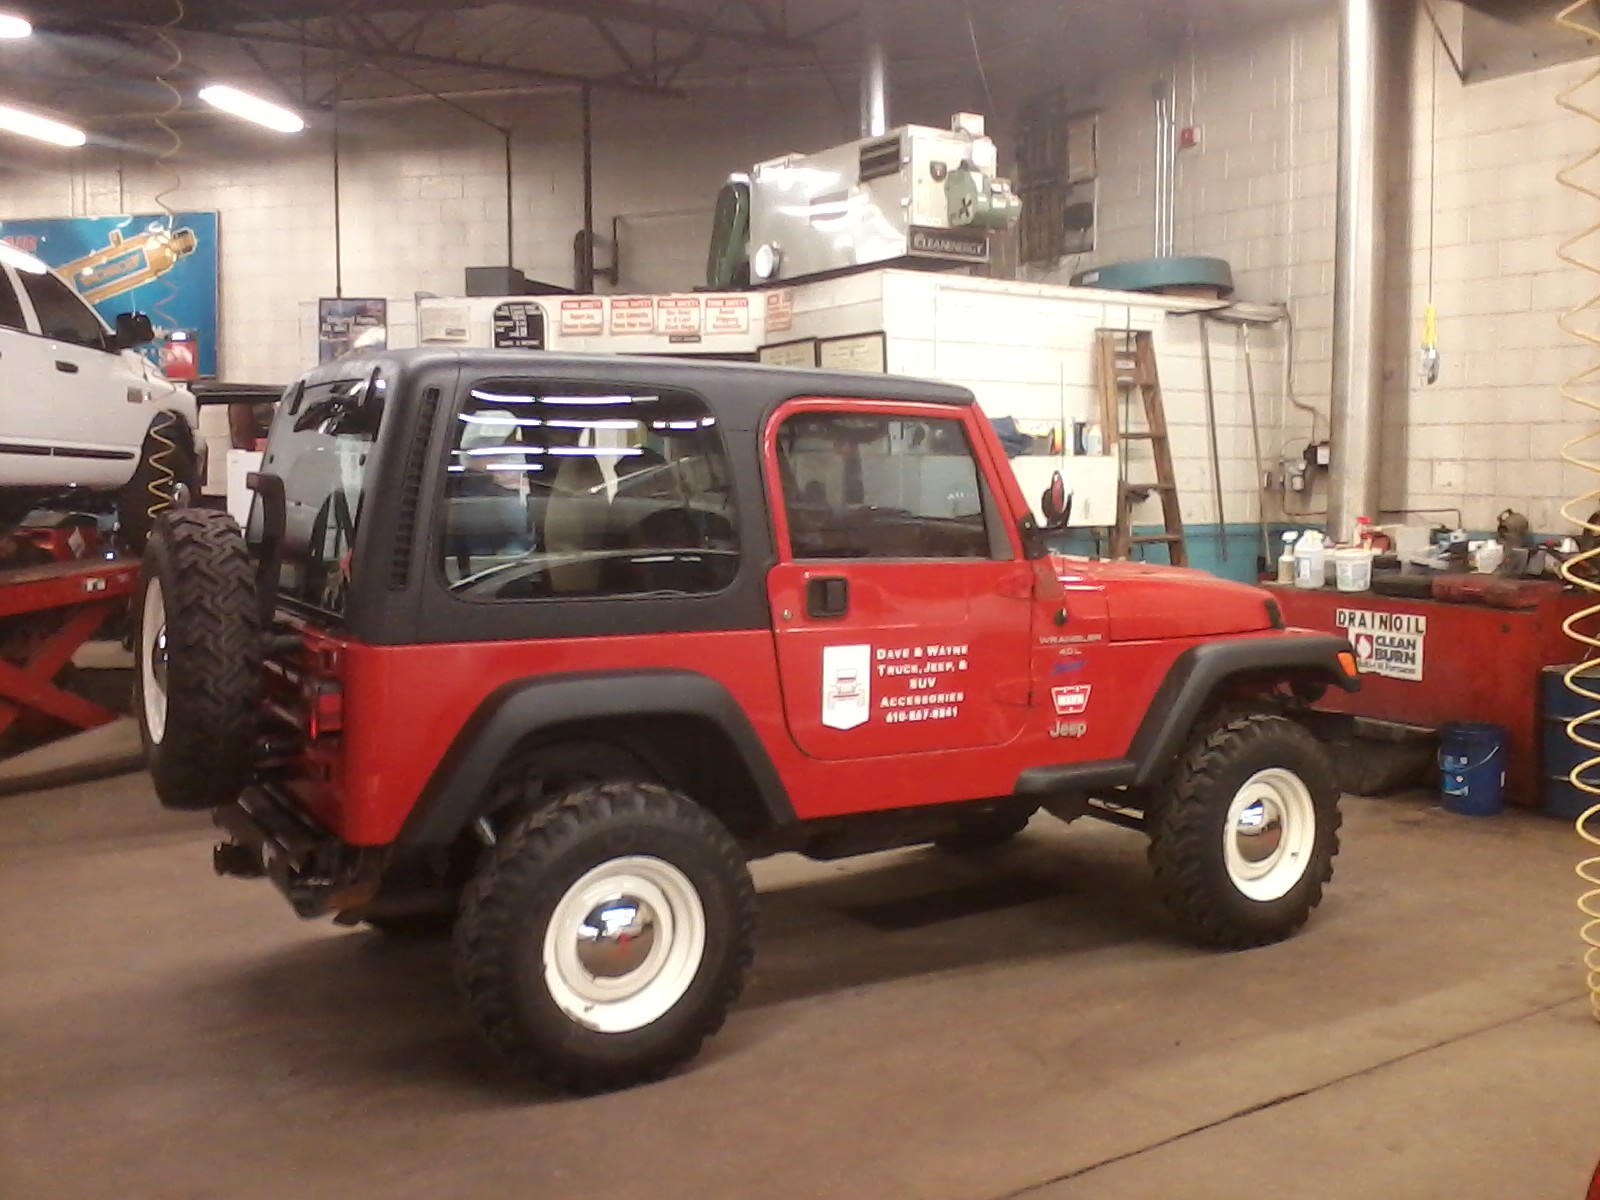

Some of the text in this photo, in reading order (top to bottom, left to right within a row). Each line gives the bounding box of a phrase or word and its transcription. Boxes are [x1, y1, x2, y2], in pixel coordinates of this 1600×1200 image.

[1337, 610, 1424, 634] DRAIN OIL
[1375, 635, 1416, 651] CLEAN
[914, 646, 923, 658] &
[1375, 648, 1416, 665] BURN
[909, 676, 937, 690] SUV
[1049, 720, 1087, 738] Jeep
